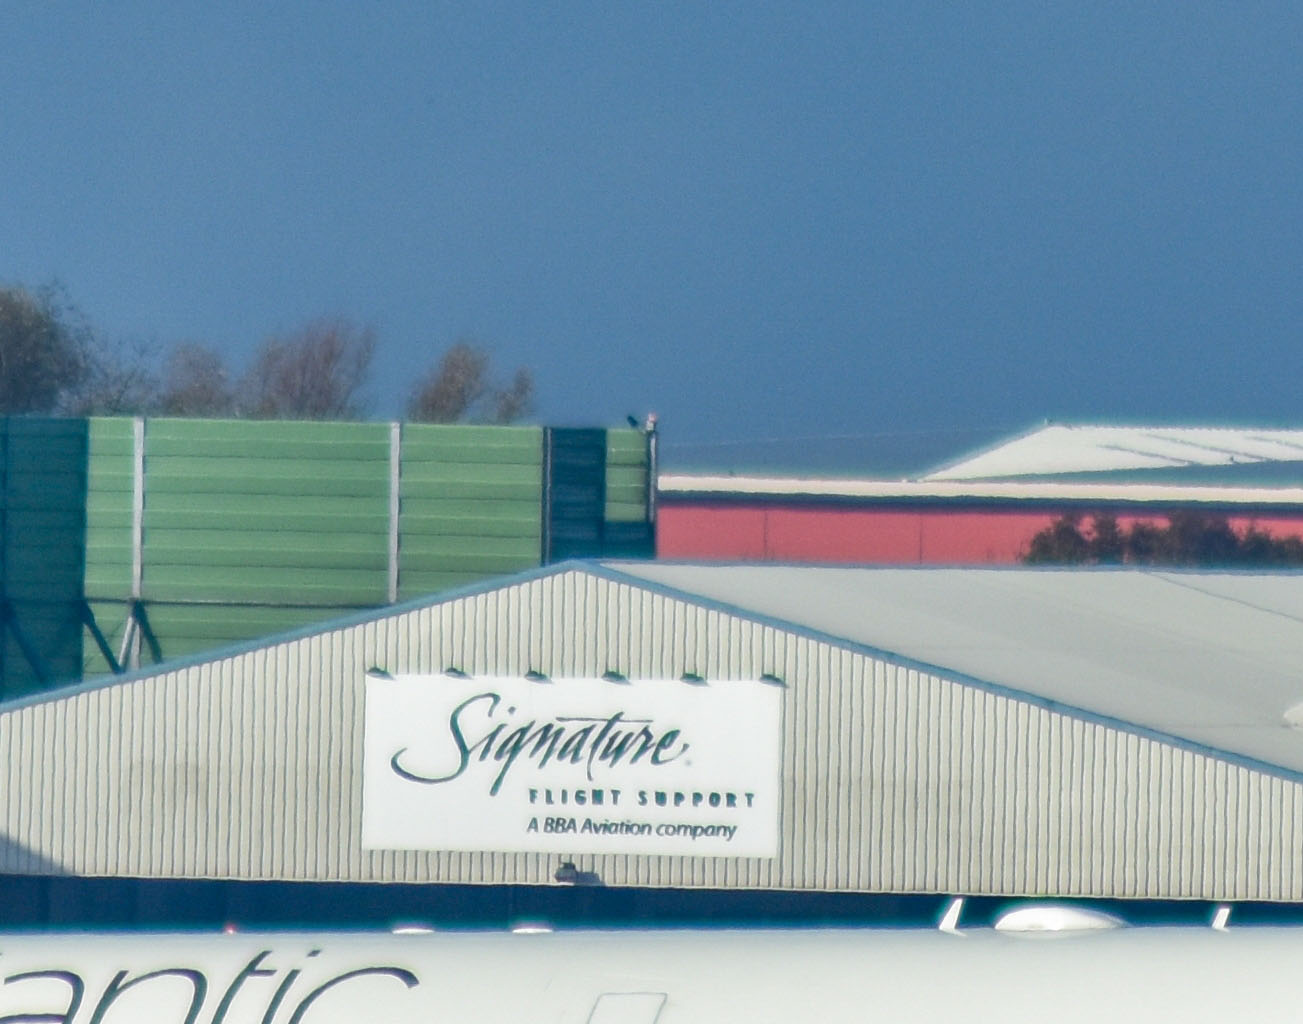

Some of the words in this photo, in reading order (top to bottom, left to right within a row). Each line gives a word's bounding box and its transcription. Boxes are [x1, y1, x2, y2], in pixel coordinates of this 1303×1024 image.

[391, 692, 691, 796] Signature
[529, 788, 621, 806] FLIGHT
[638, 790, 755, 808] SUPPORT
[526, 816, 539, 833] A
[543, 816, 578, 834] BBA
[580, 817, 652, 836] Aviation
[655, 821, 738, 842] company
